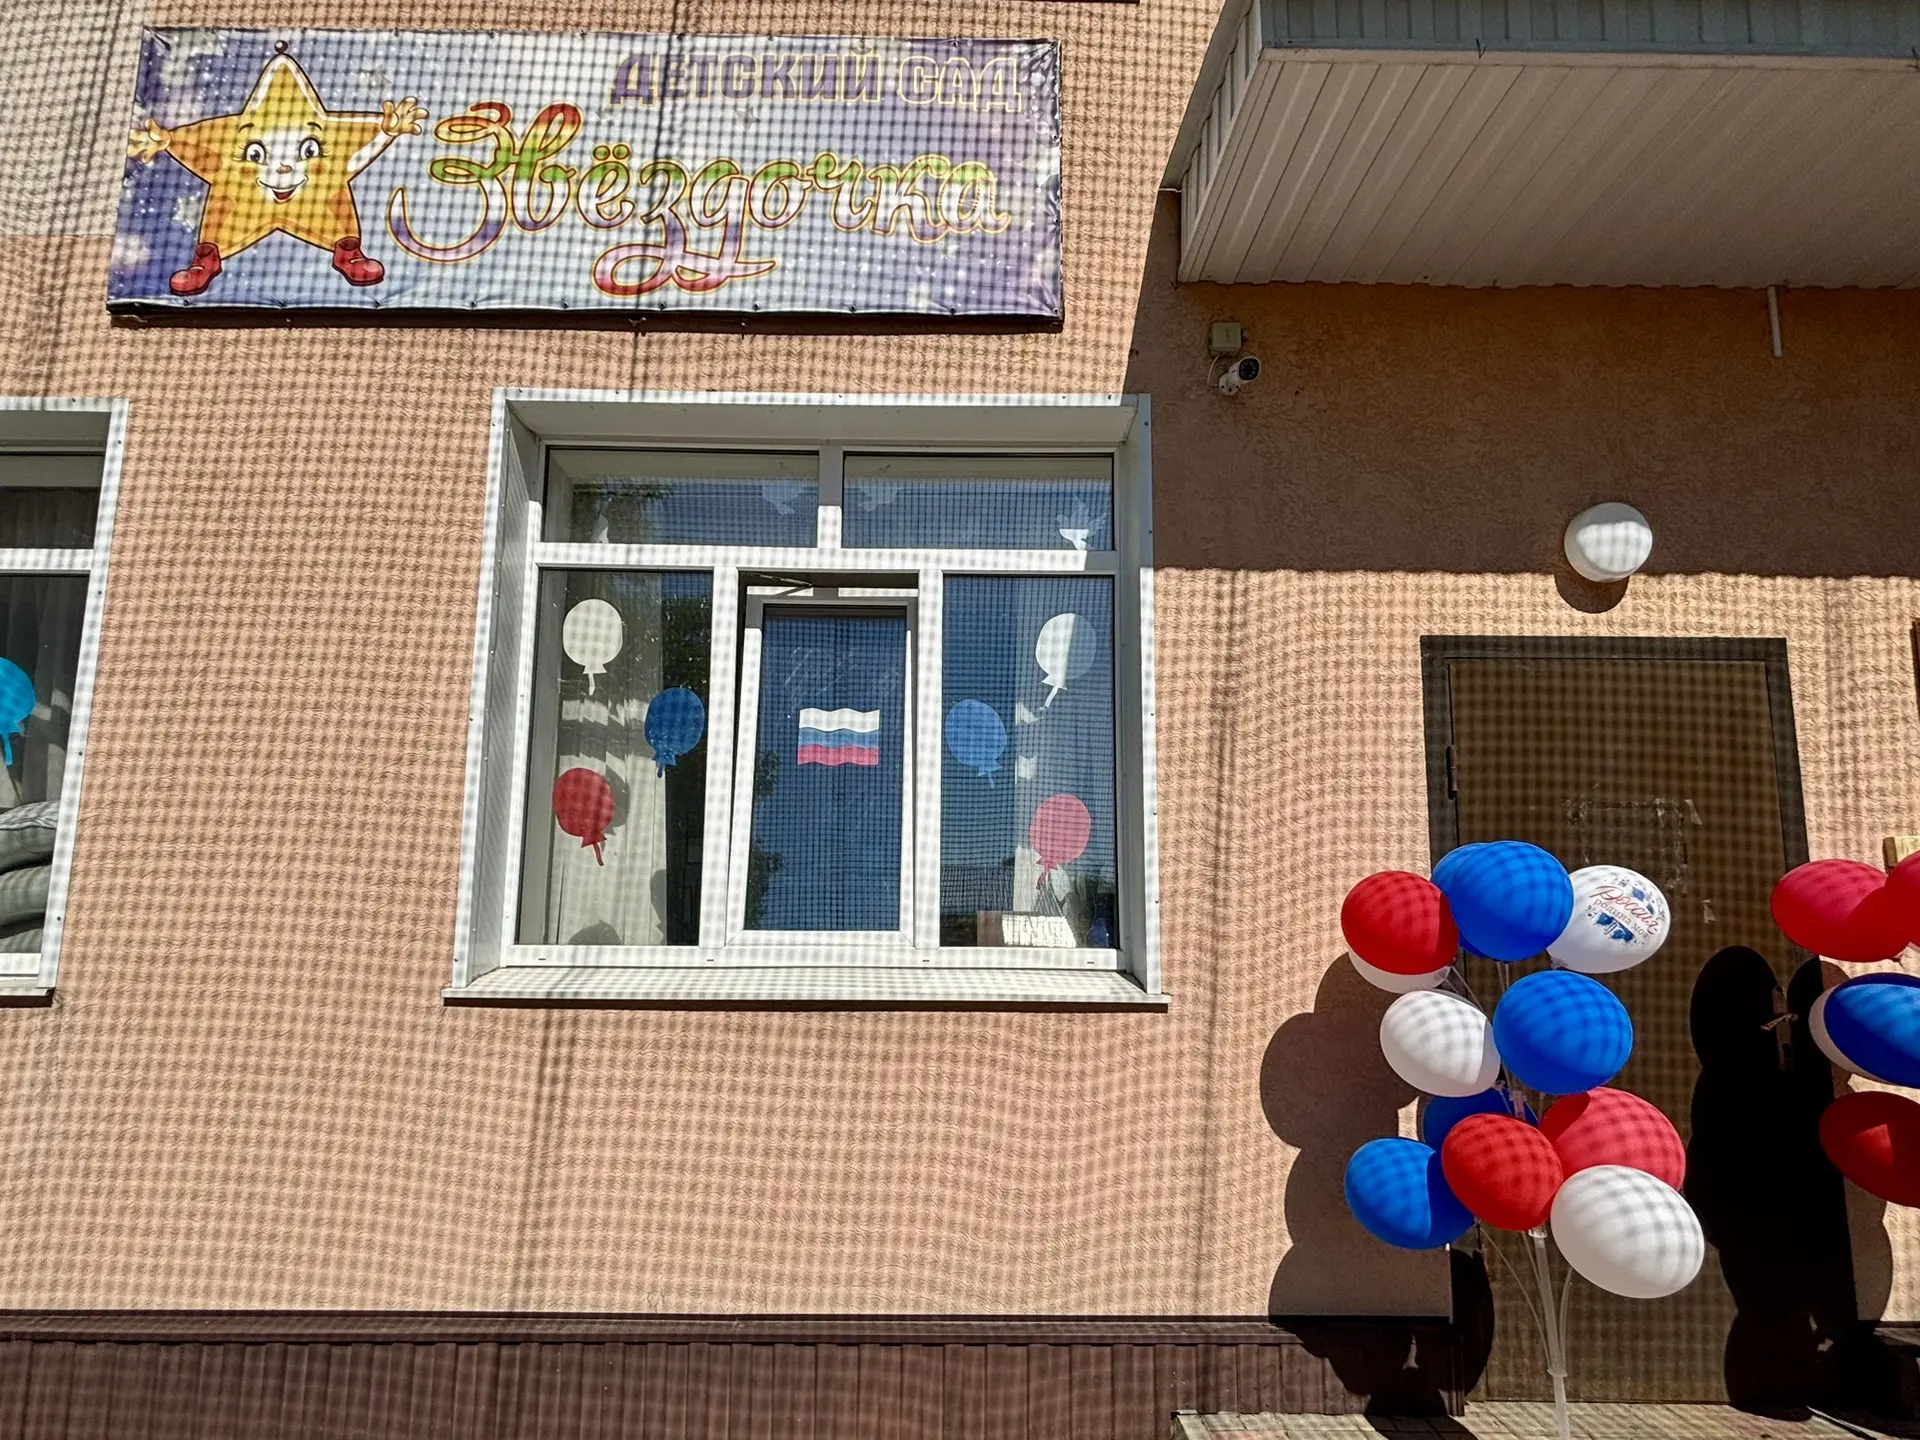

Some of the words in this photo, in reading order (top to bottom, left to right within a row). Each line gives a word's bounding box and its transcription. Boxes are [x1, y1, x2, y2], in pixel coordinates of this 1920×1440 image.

[609, 48, 884, 106] ДЕТСКИЙ
[898, 55, 1022, 113] САД
[387, 101, 1012, 296] Звёздочка
[1589, 885, 1659, 935] Россия
[1593, 898, 1632, 926] родина
[1632, 922, 1650, 940] моя
